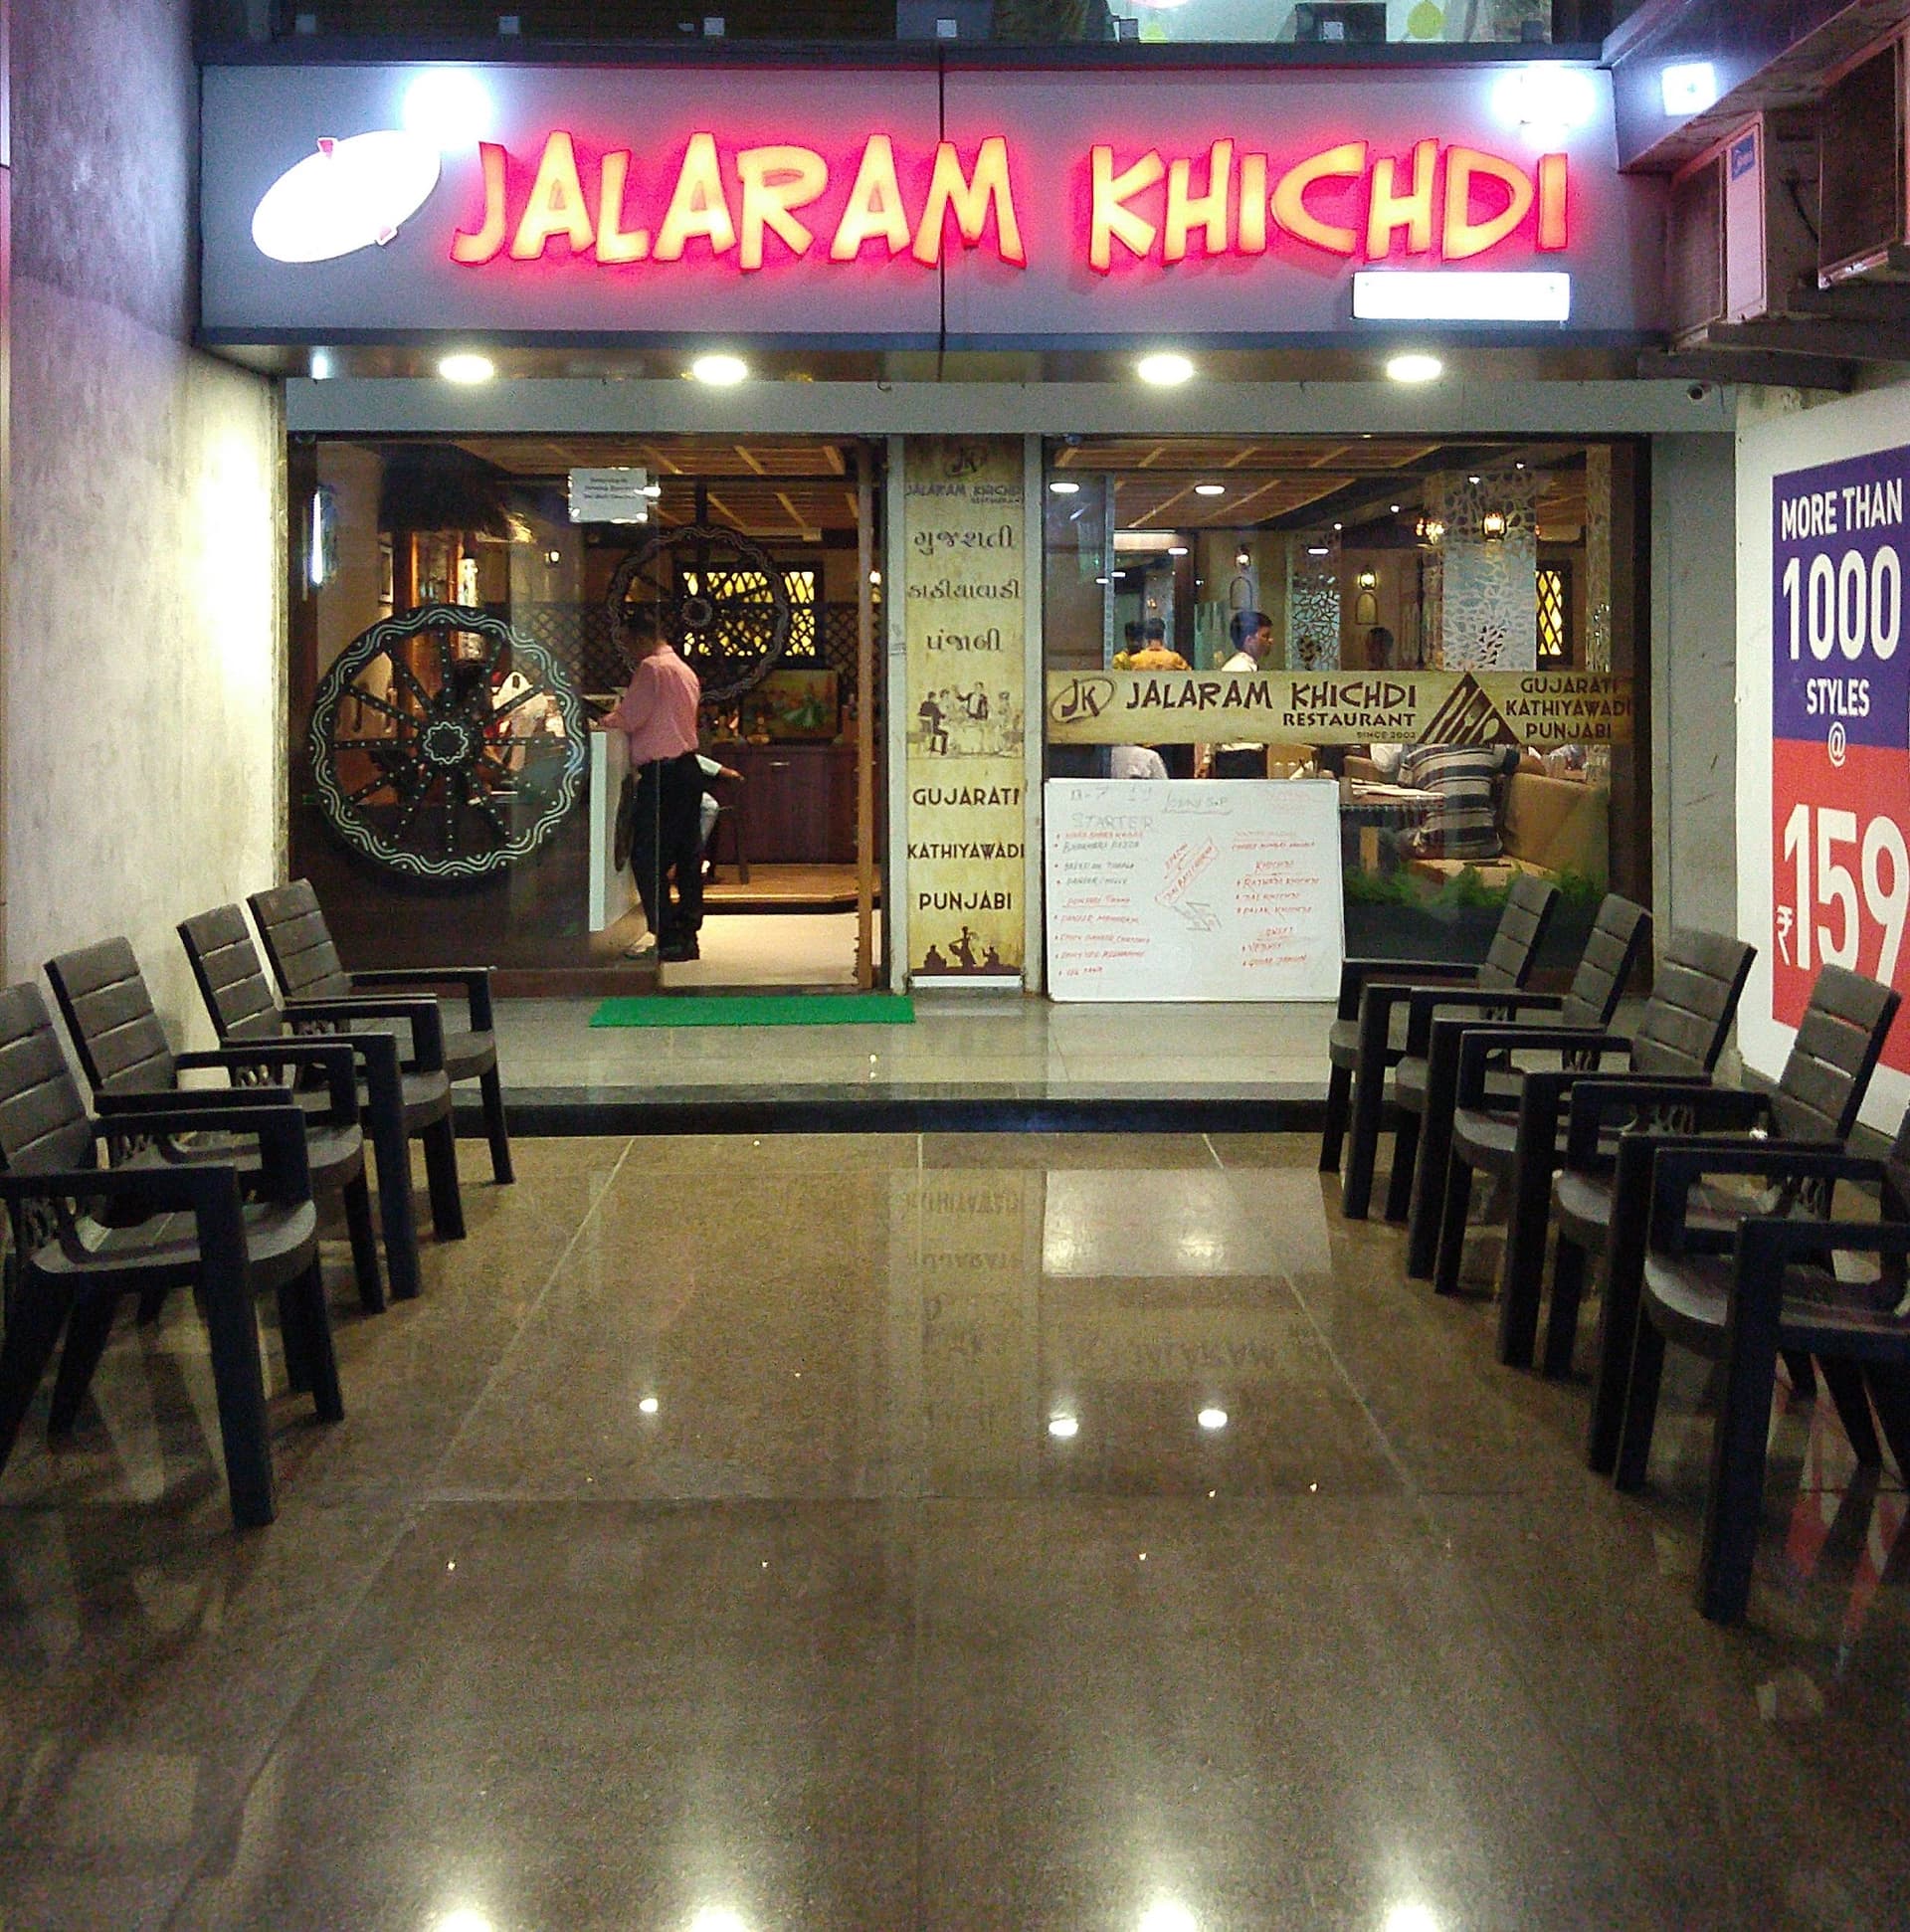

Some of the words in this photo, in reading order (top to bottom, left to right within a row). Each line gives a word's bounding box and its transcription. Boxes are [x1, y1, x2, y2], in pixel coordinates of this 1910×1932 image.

[451, 130, 1027, 273] JALARAM
[1089, 137, 1568, 275] KHICHDI
[1782, 489, 1837, 541] MORE
[1842, 478, 1903, 531] THAN
[1783, 545, 1902, 661] 1000
[1126, 679, 1273, 710] JALARAM
[1290, 680, 1418, 710] KHICHDI
[1520, 676, 1618, 694] GUJARATI
[1505, 696, 1631, 717] KATHIYAWADI
[1806, 677, 1870, 717] STYLES
[1282, 711, 1417, 727] RESTAURANT
[1526, 720, 1612, 740] PUNJABI
[1827, 721, 1846, 767] @
[912, 786, 1020, 806] GUJARATI
[906, 842, 1025, 860] KATHIYAWADI
[918, 891, 1012, 910] PUNJABI
